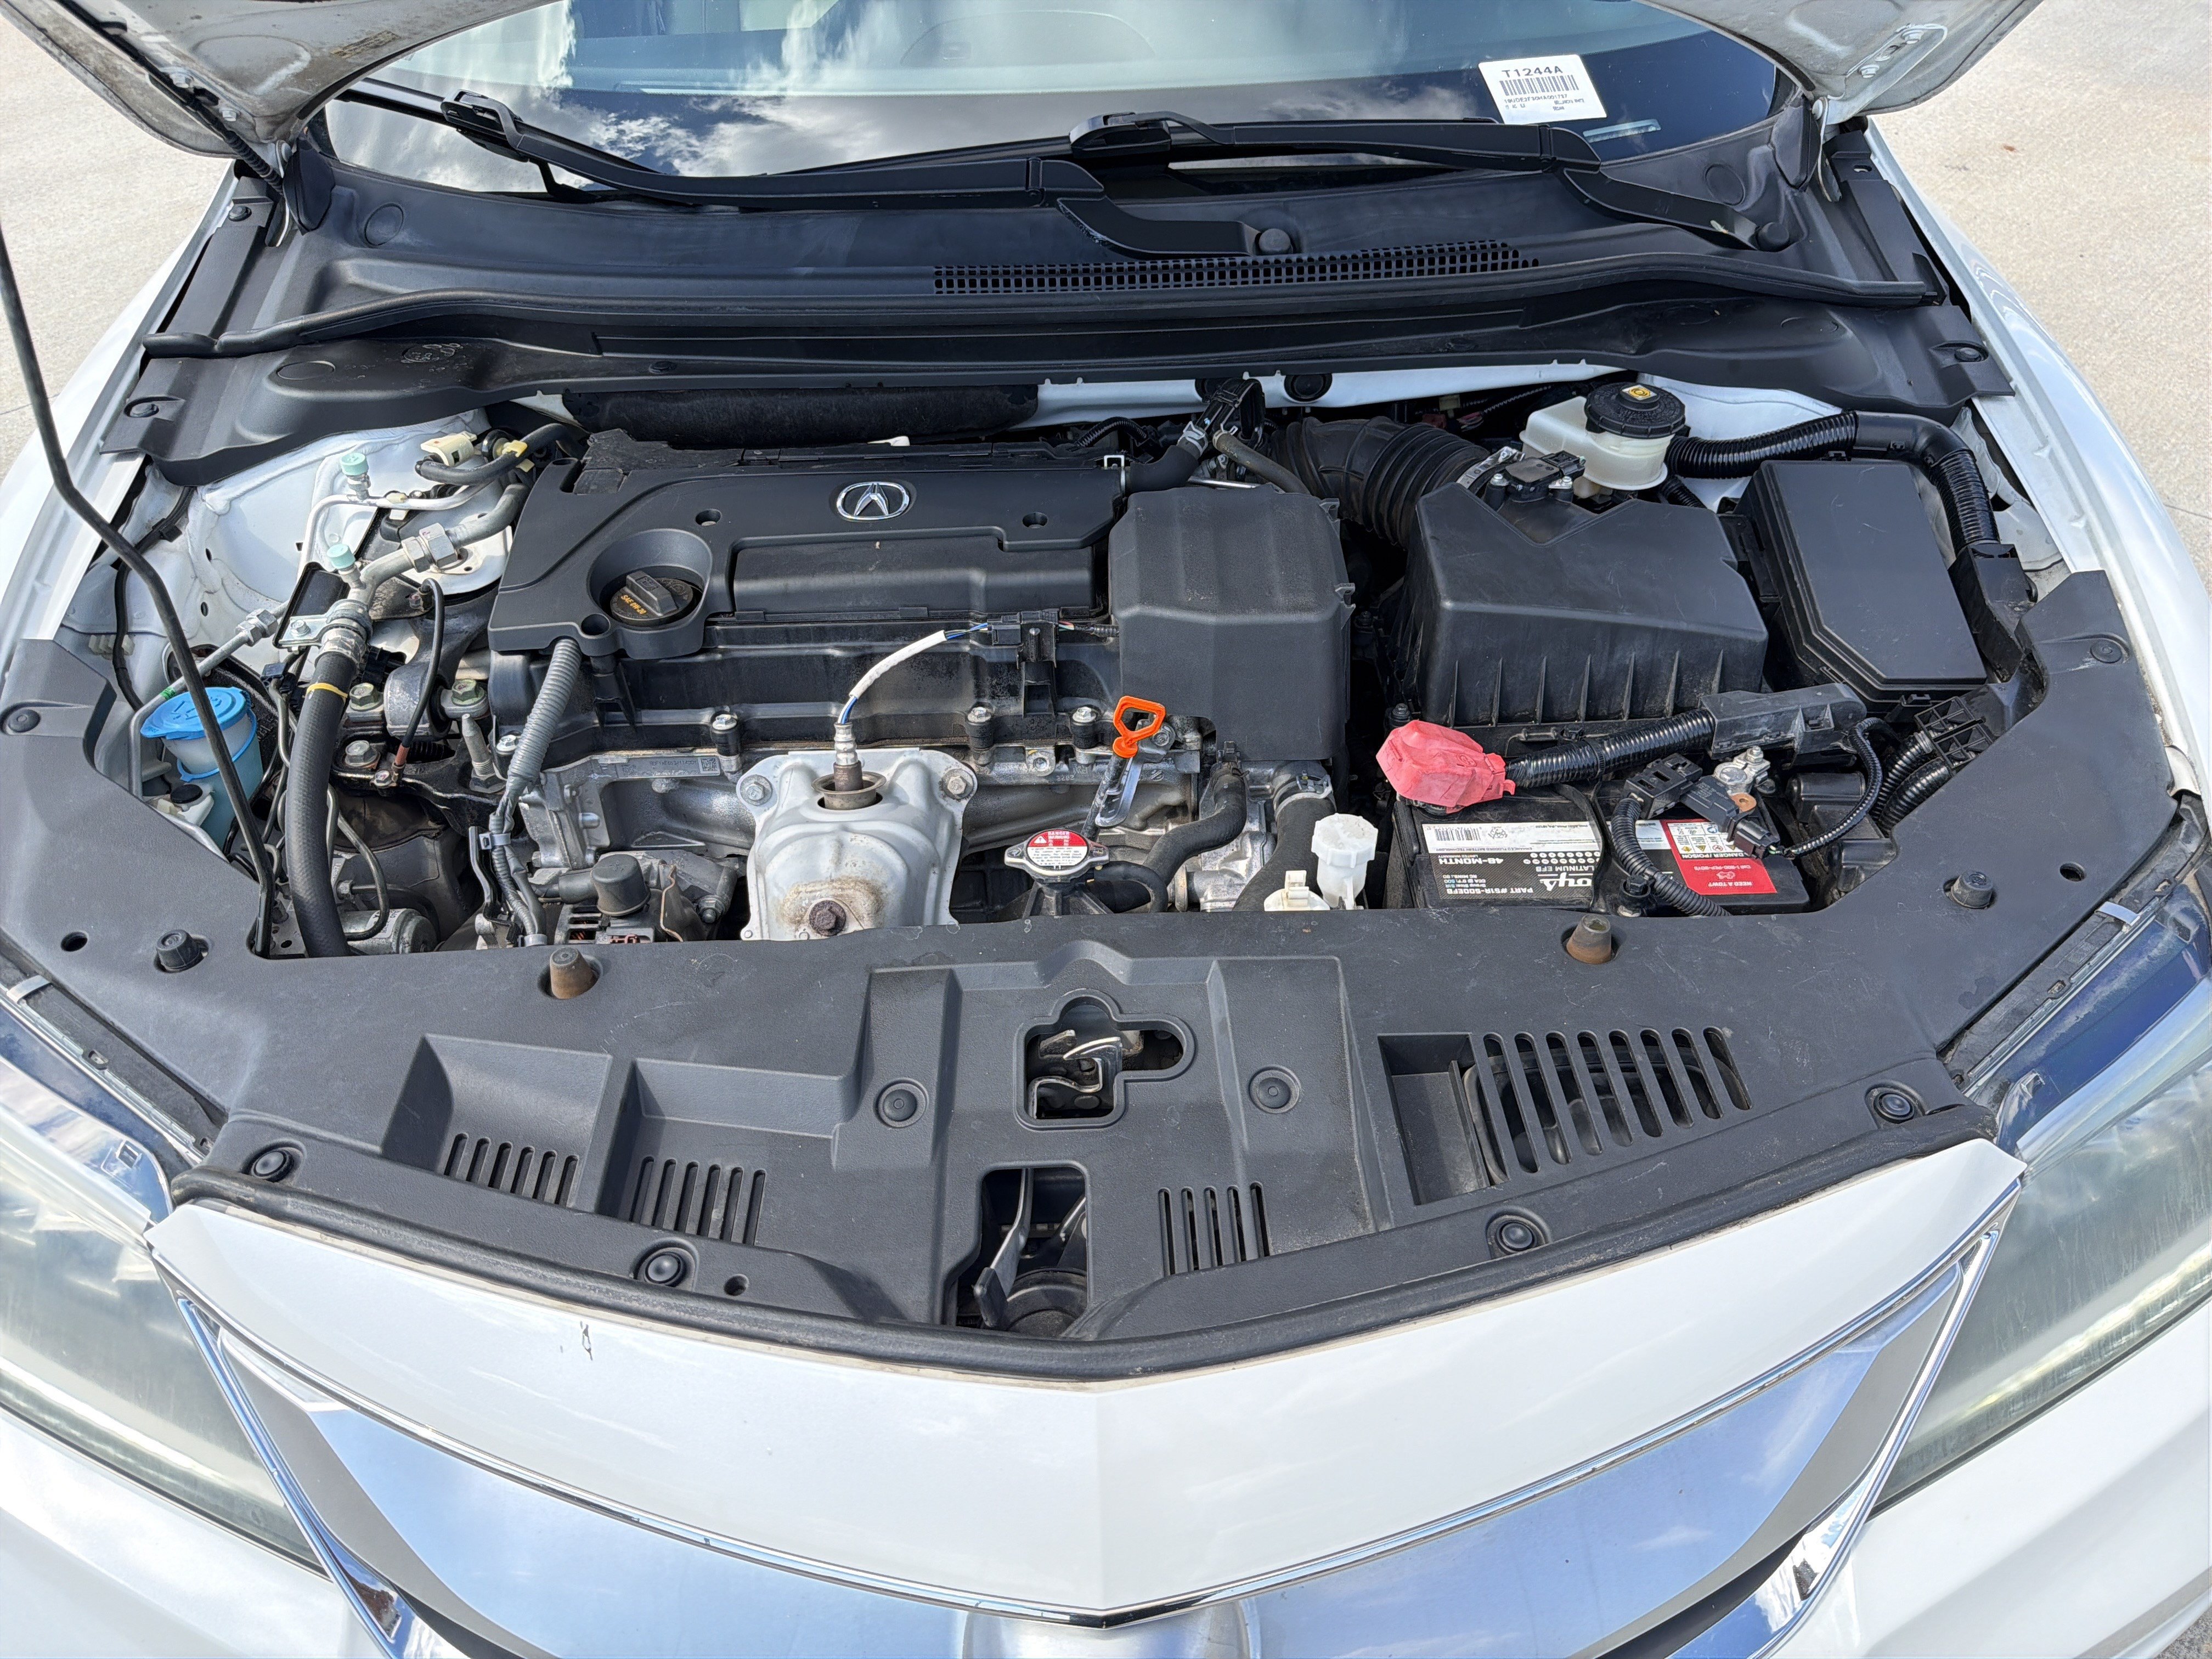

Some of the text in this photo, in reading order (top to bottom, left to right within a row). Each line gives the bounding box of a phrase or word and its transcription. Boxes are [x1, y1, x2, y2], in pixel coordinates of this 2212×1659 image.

[1501, 65, 1564, 78] T1244A
[620, 594, 647, 614] SAE 0W-20
[1539, 872, 1592, 891] oys
